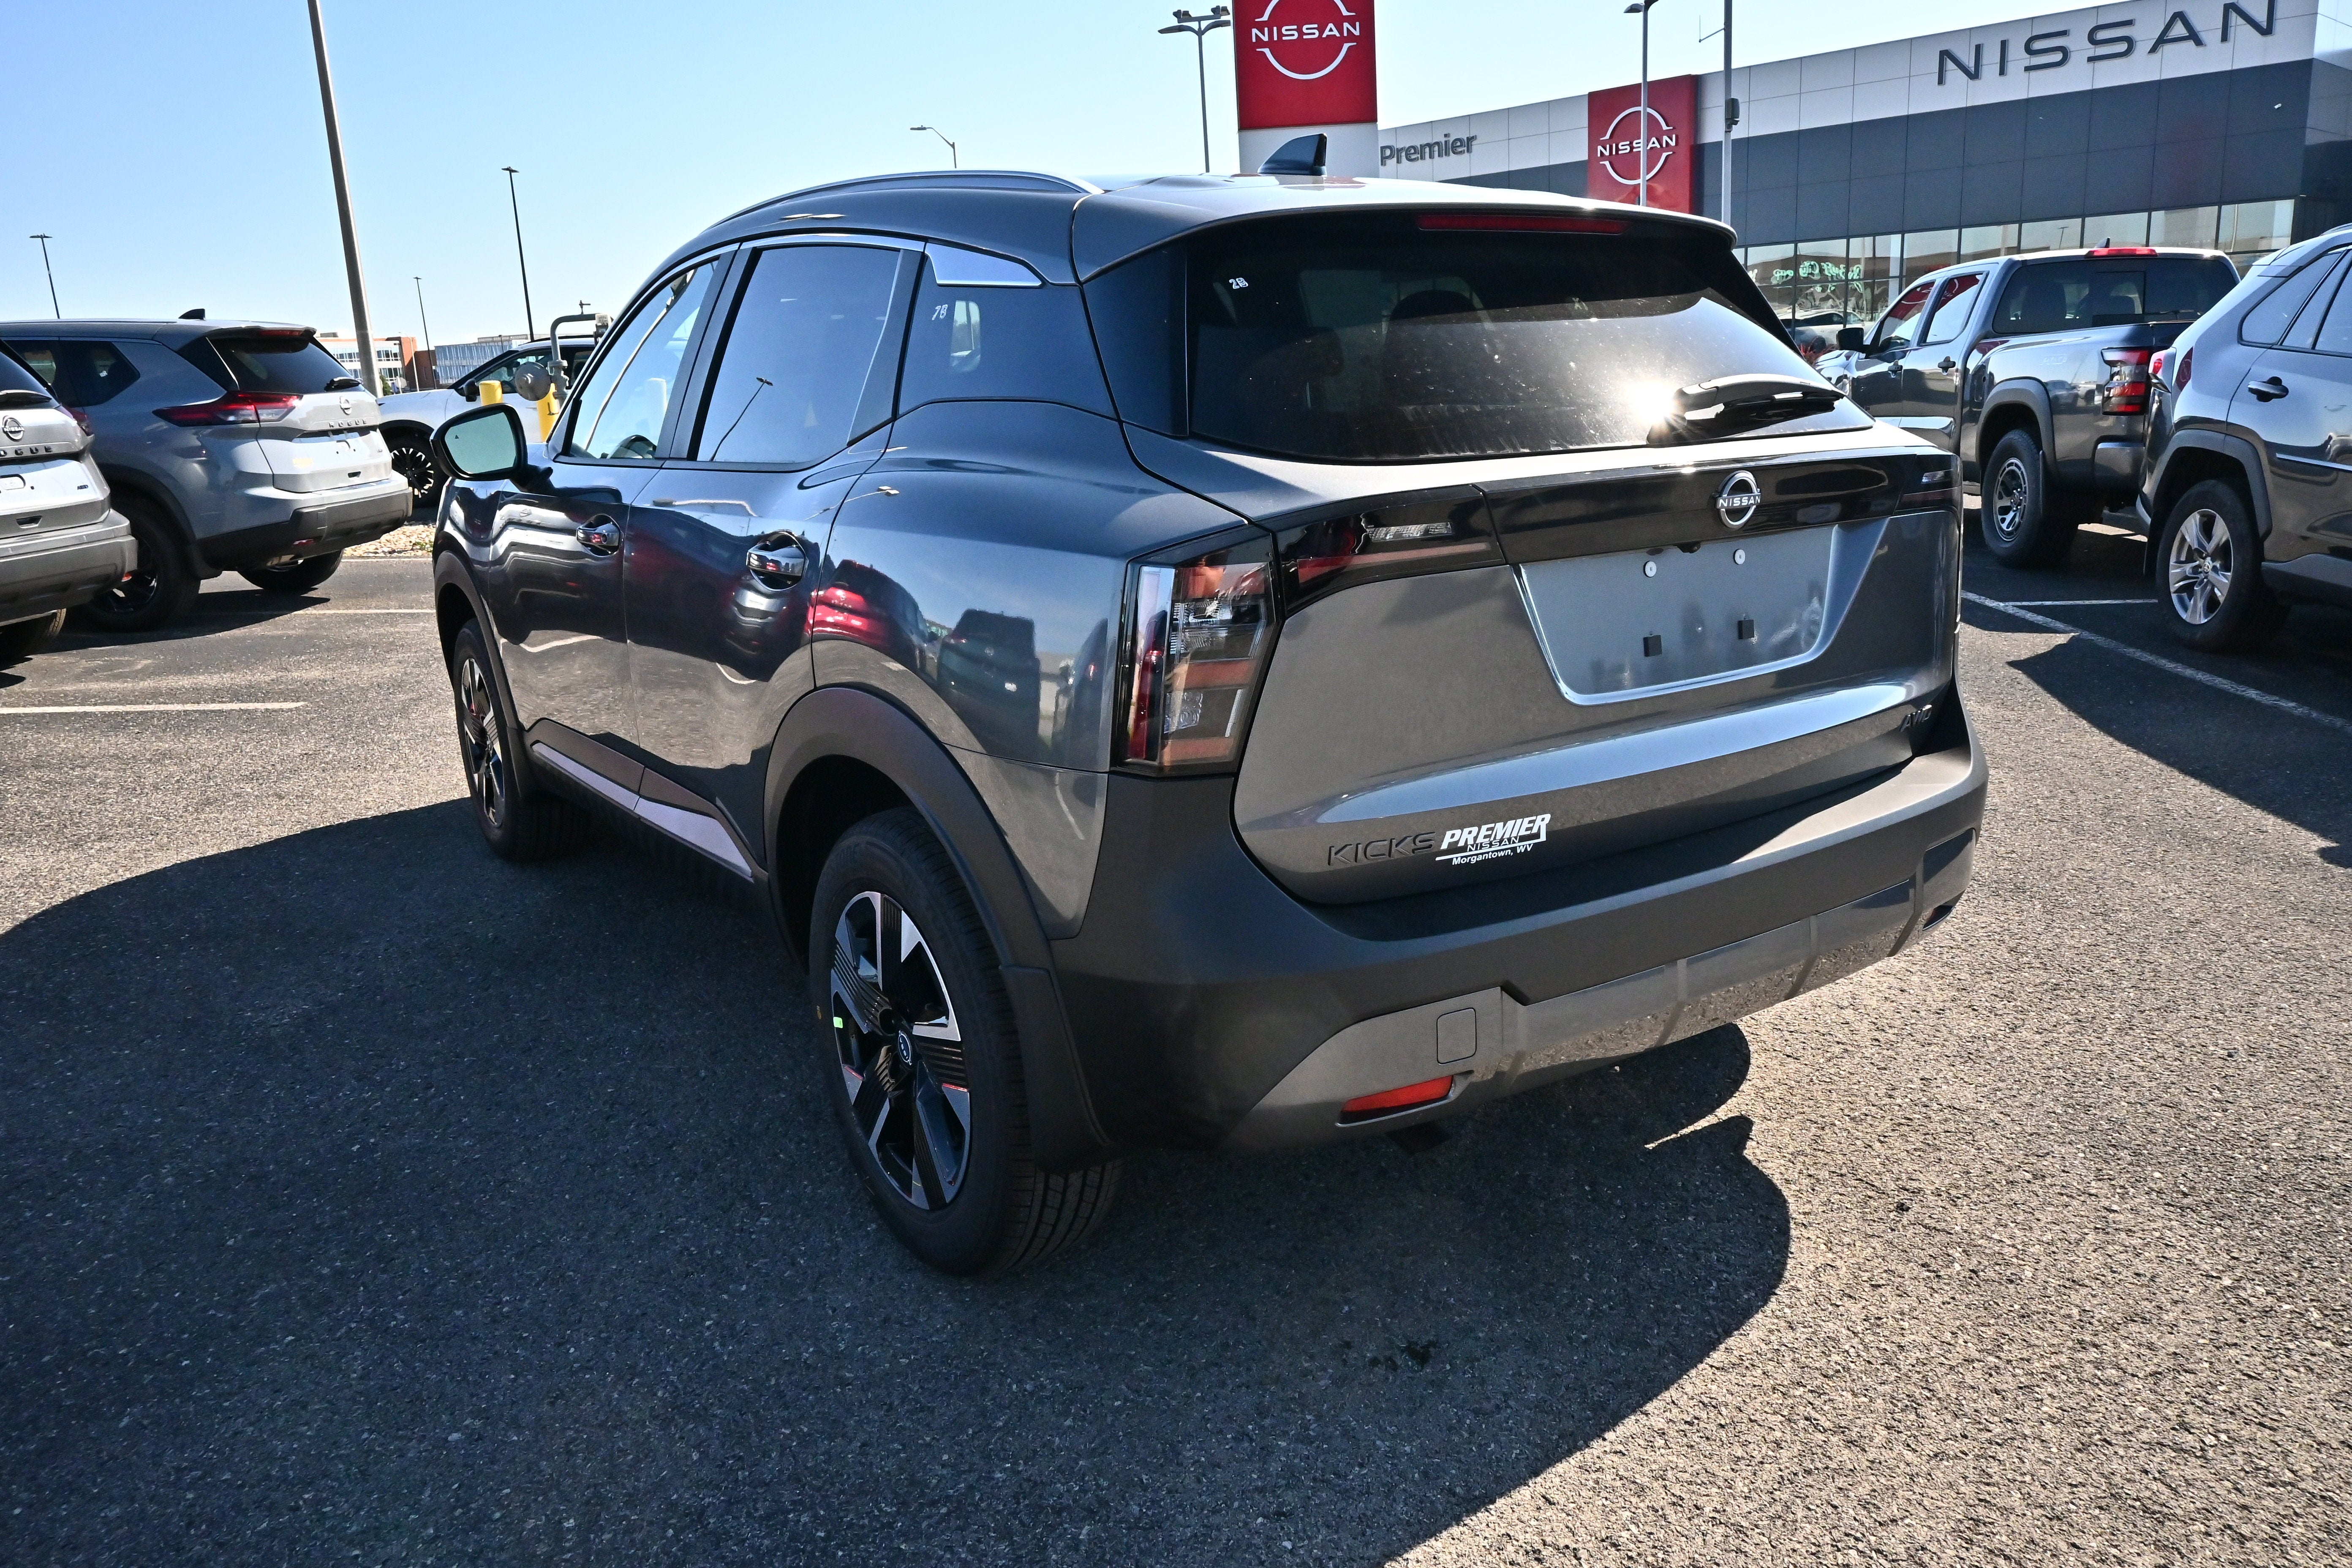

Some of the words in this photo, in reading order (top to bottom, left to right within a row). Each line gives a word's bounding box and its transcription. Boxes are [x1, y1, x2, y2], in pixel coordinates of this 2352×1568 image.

[1252, 22, 1360, 42] NISSAN
[1937, 0, 2276, 85] NISSAN
[1380, 133, 1477, 166] Premier
[1598, 134, 1676, 157] NISSAN
[329, 419, 367, 428] ROGUE
[1719, 495, 1761, 507] NISSAN
[1440, 814, 1551, 849] PREMIER
[1328, 832, 1435, 866] KICKS
[1452, 848, 1513, 865] Morgantown,
[1517, 844, 1533, 853] WV
[1467, 836, 1520, 852] NISSAN
